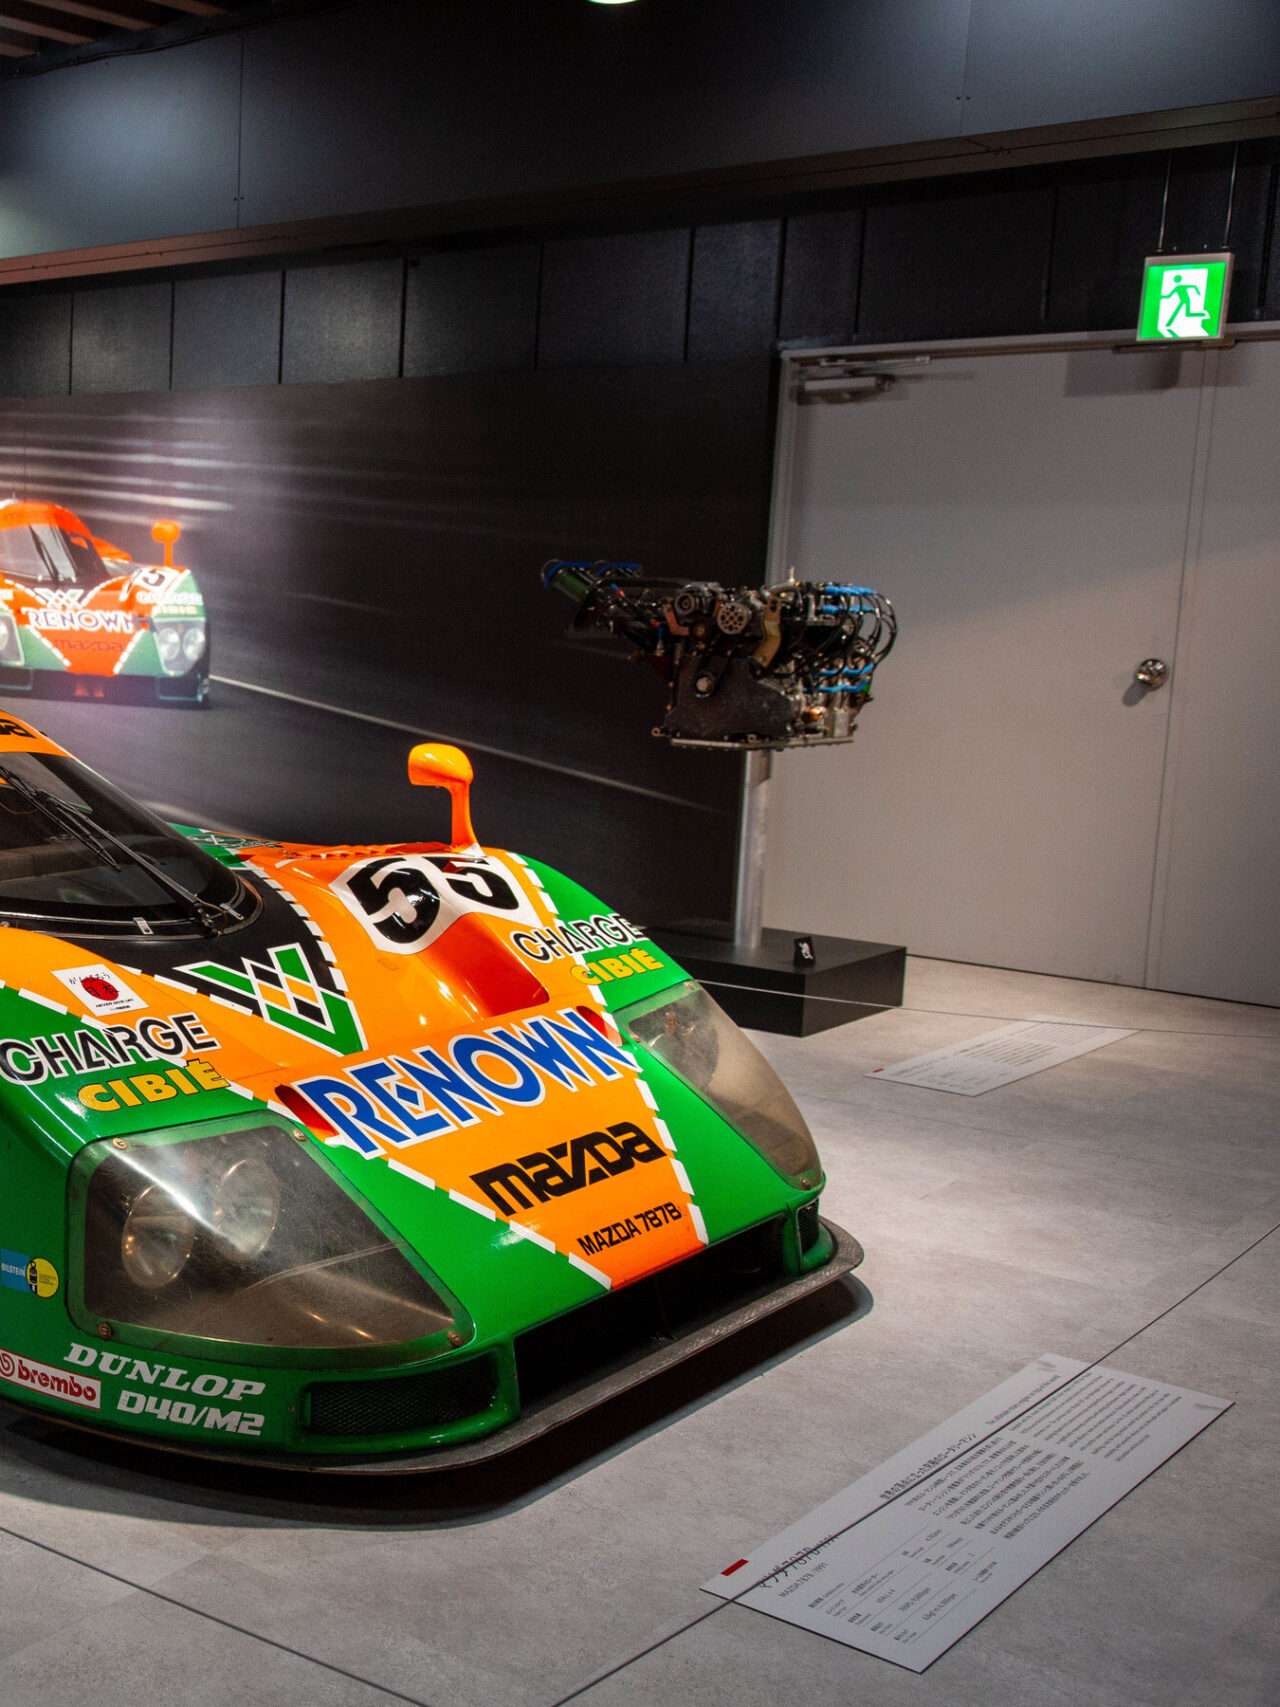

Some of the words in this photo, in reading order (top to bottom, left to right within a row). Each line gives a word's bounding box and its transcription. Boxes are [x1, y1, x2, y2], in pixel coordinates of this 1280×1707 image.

[21, 607, 135, 633] RENOWN
[347, 856, 520, 944] 55
[510, 913, 649, 963] CHARGE
[291, 1008, 642, 1160] RENOWN
[469, 1121, 667, 1217] mazda
[576, 1218, 642, 1256] MAZDA
[634, 1202, 682, 1231] 787B
[18, 1360, 97, 1401] brembo
[64, 1343, 266, 1400] DUNLOP
[117, 1390, 265, 1436] D40/M2
